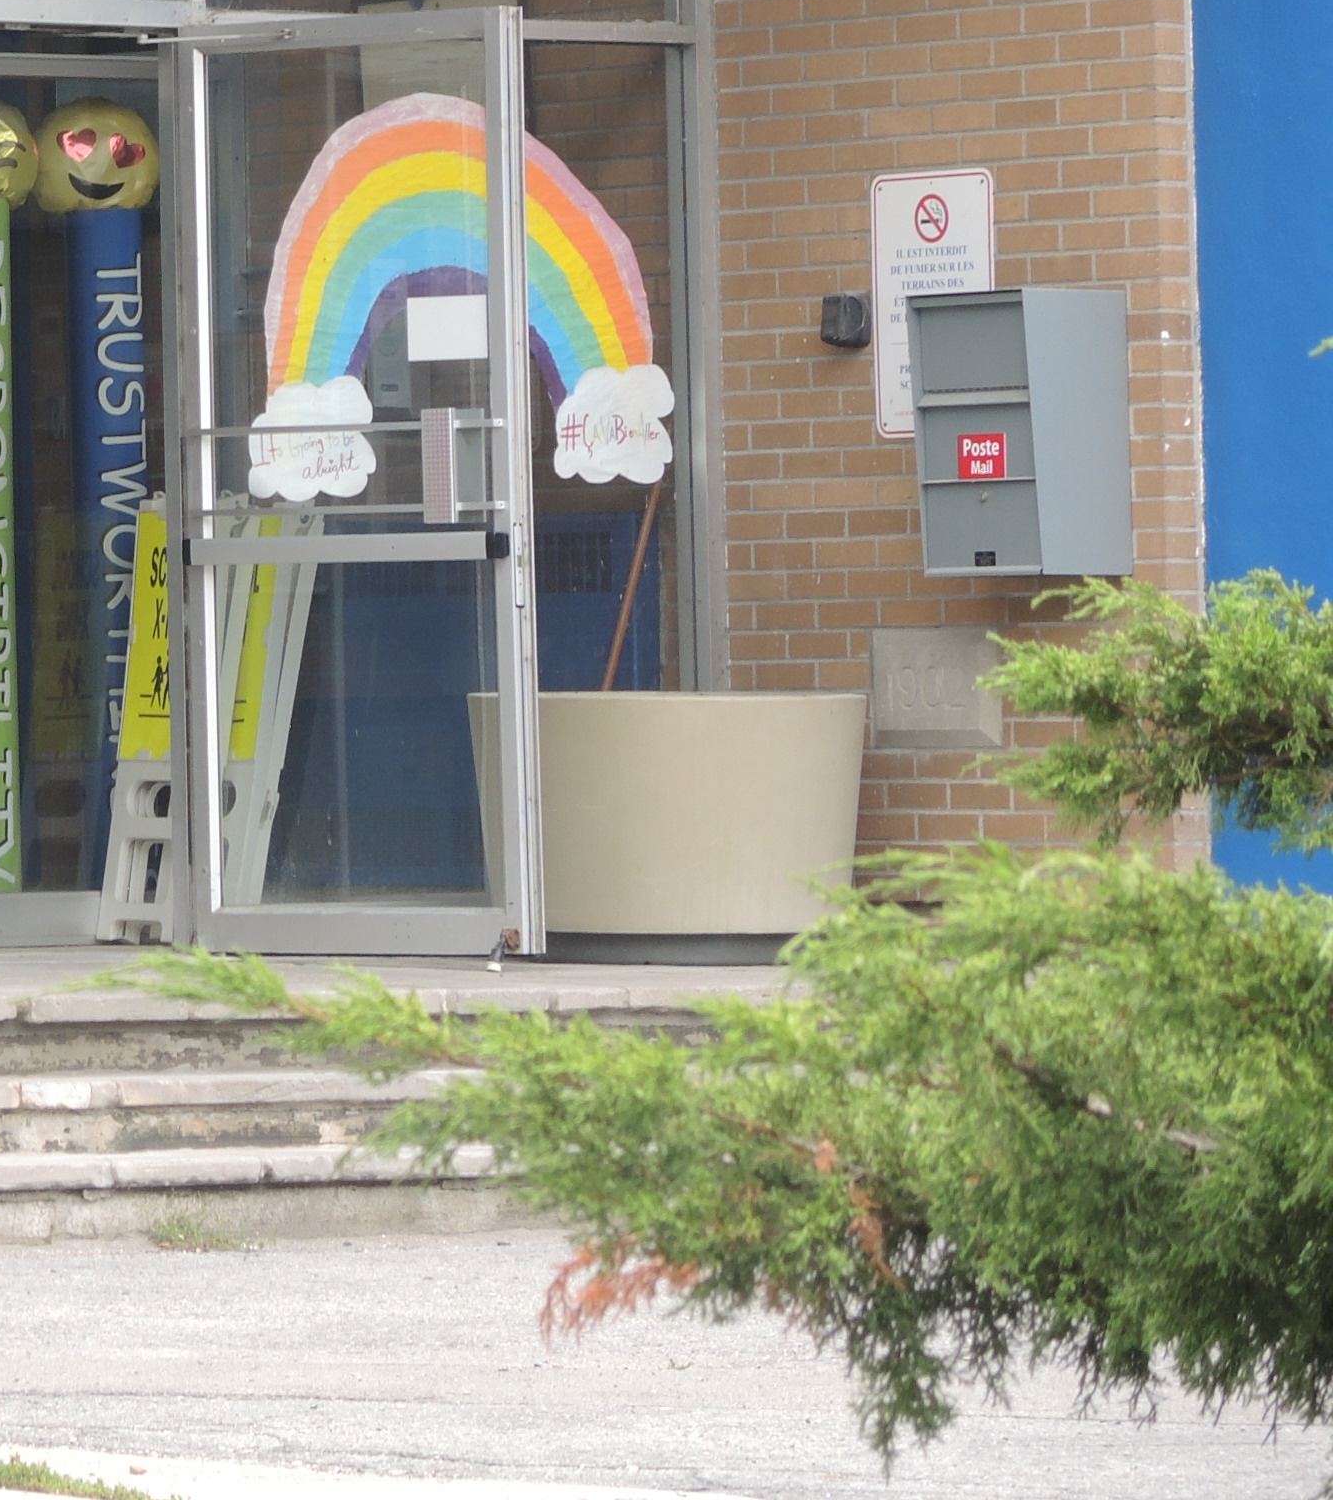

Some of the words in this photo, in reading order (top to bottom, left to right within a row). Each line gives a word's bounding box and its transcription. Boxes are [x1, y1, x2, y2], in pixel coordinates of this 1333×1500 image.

[896, 248, 906, 259] IL
[907, 248, 923, 258] EST
[925, 245, 968, 257] INTERDIT
[890, 264, 903, 275] DE
[905, 262, 936, 274] FUMER
[938, 261, 956, 273] SUR
[958, 260, 975, 271] LES
[901, 278, 946, 291] TERRAINS
[947, 277, 965, 288] DES
[962, 438, 1000, 457] Poste
[302, 450, 360, 481] alright
[970, 459, 993, 475] Mail
